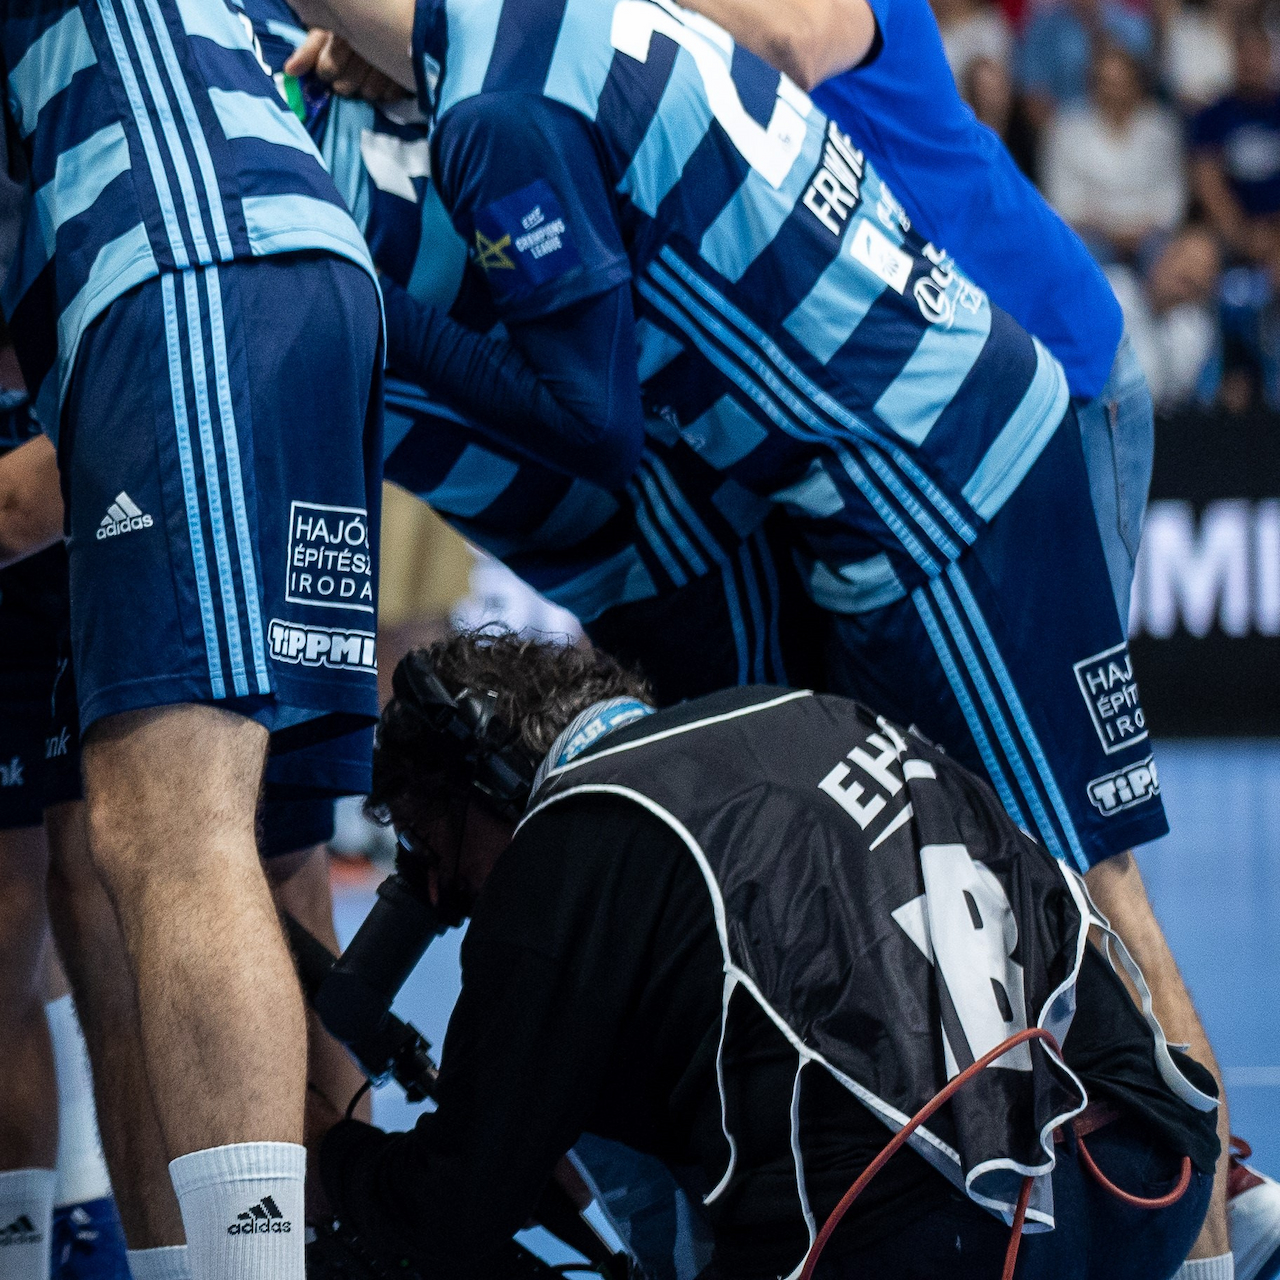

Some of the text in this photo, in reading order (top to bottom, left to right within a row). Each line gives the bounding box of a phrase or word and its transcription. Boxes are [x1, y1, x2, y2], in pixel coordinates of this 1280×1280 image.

[96, 514, 154, 540] adidas
[291, 571, 372, 601] IRODA
[226, 1217, 292, 1236] adidas
